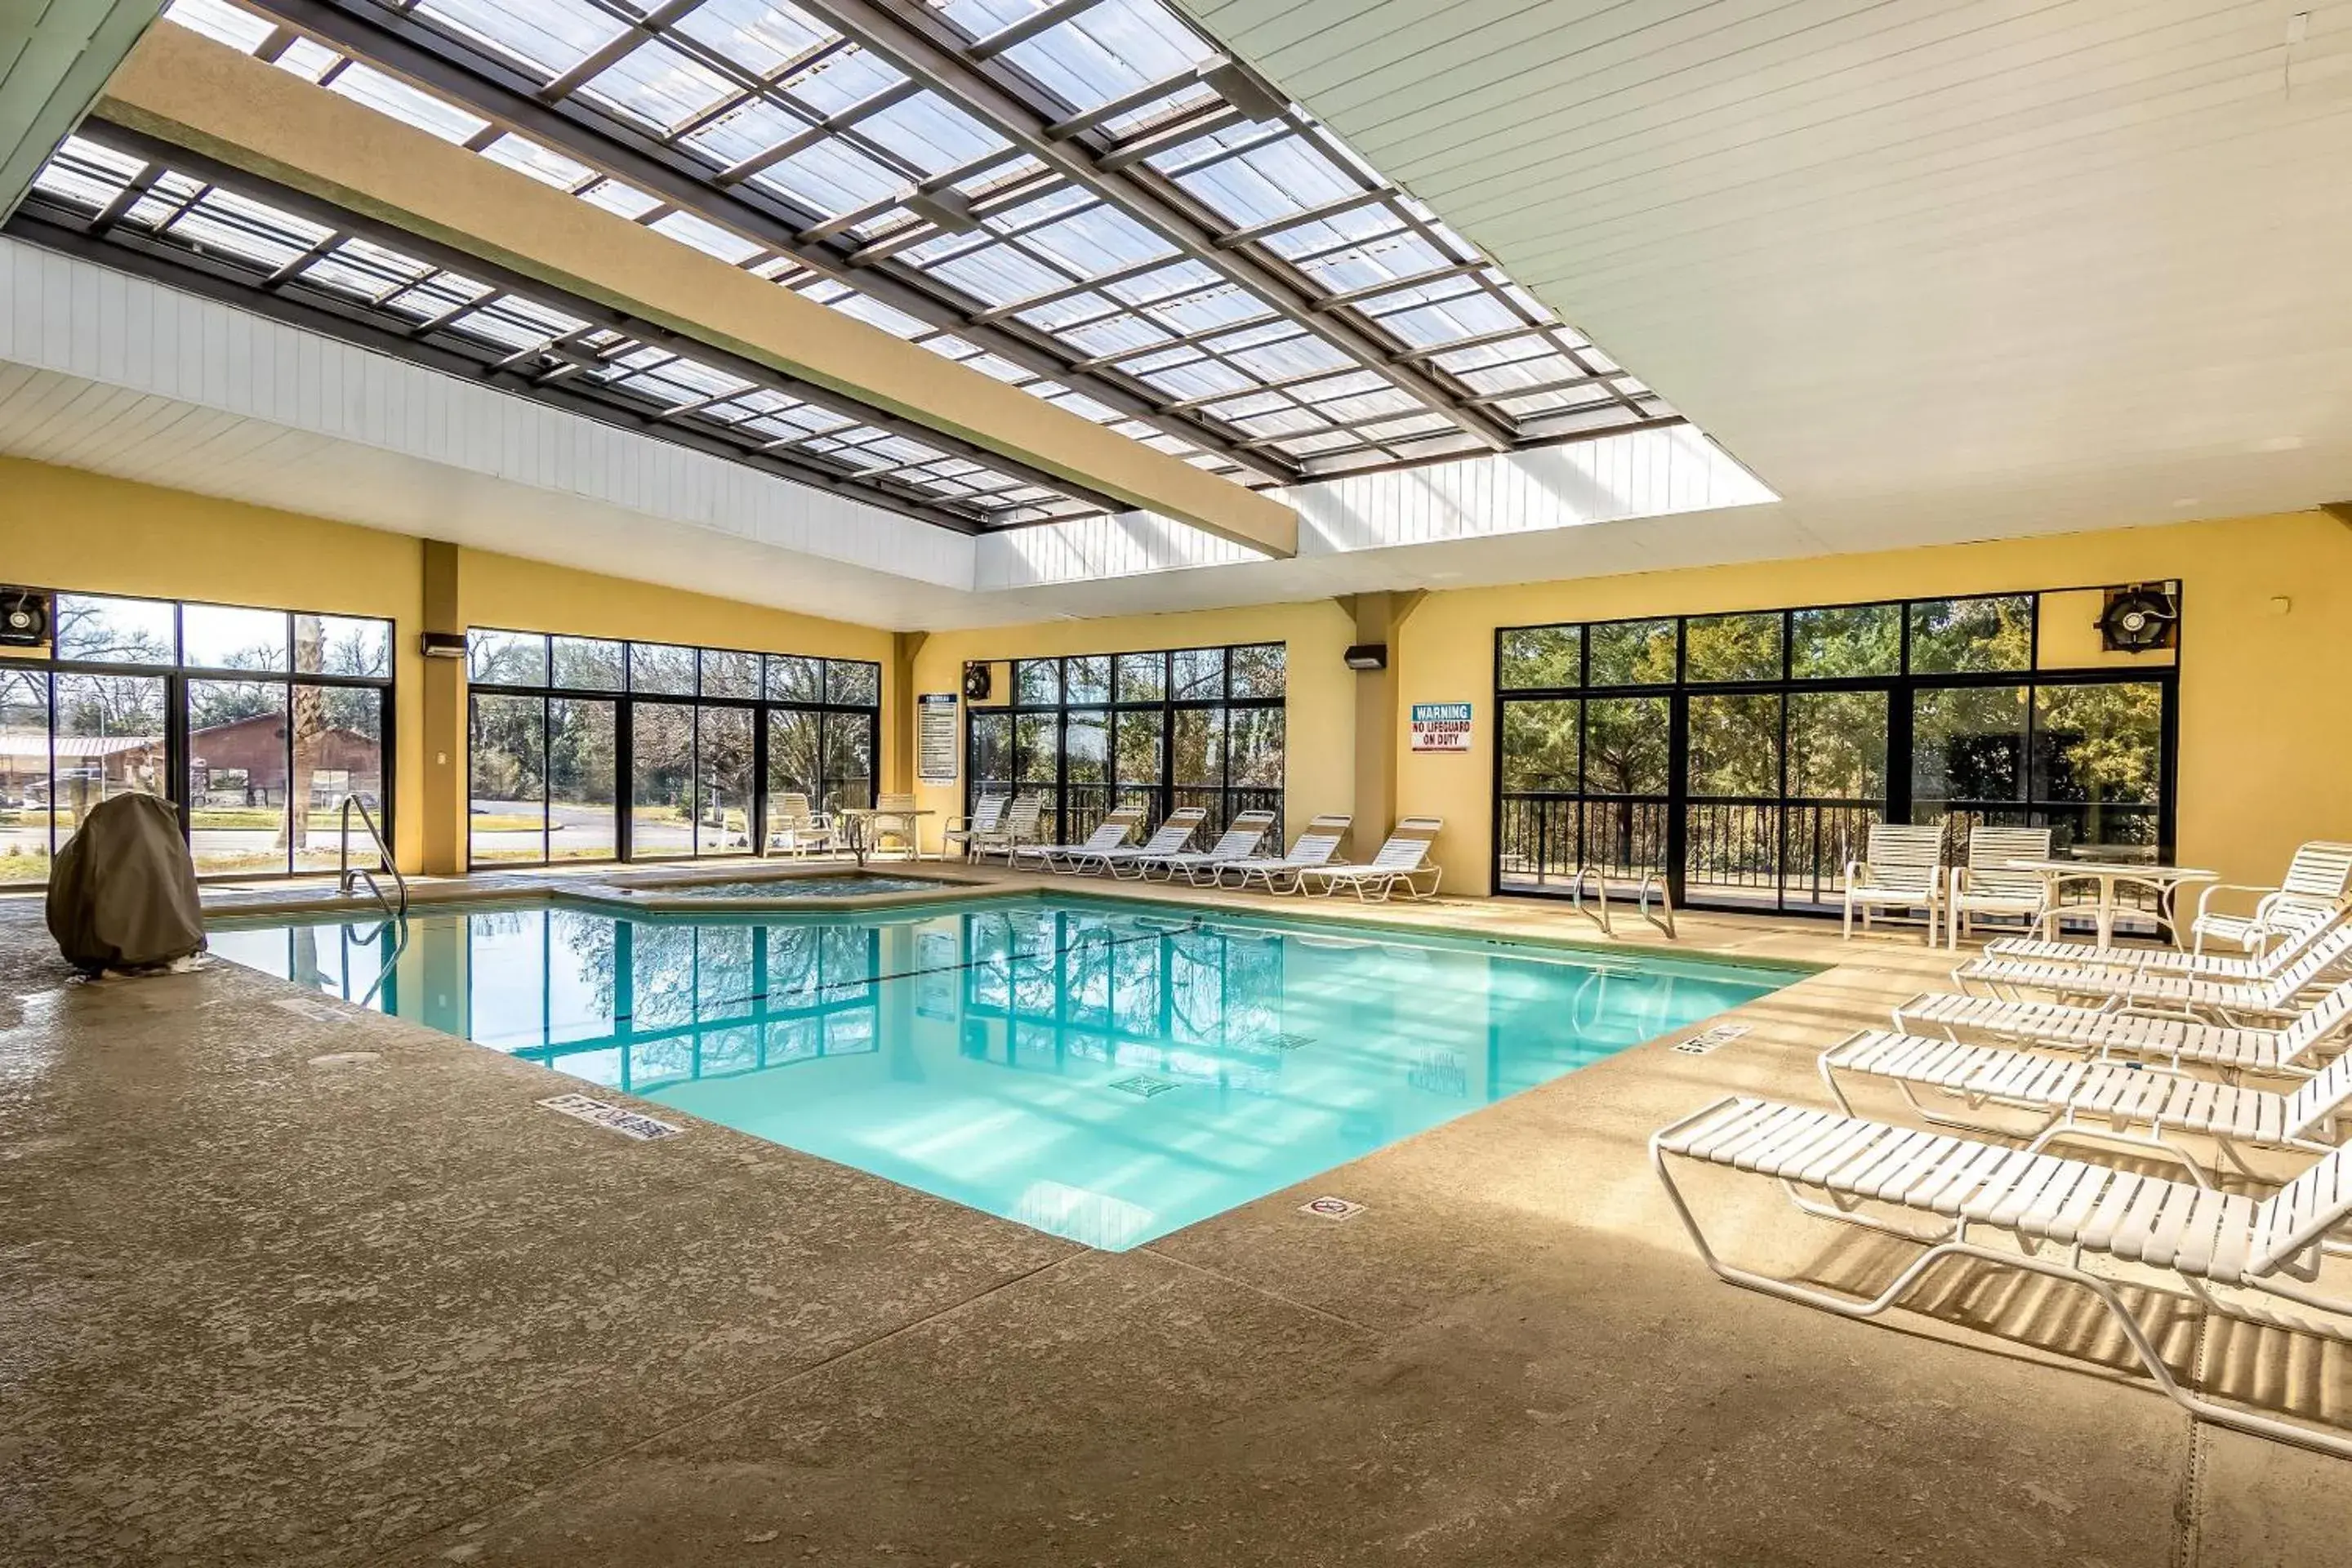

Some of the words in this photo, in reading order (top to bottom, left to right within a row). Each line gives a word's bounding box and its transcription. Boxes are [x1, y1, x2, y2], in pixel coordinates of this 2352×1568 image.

[1417, 705, 1468, 720] WARNING
[1413, 722, 1424, 733] NO
[1427, 721, 1470, 733] LIFEGUARD
[1423, 734, 1435, 745] ON
[1437, 733, 1459, 745] DUTY
